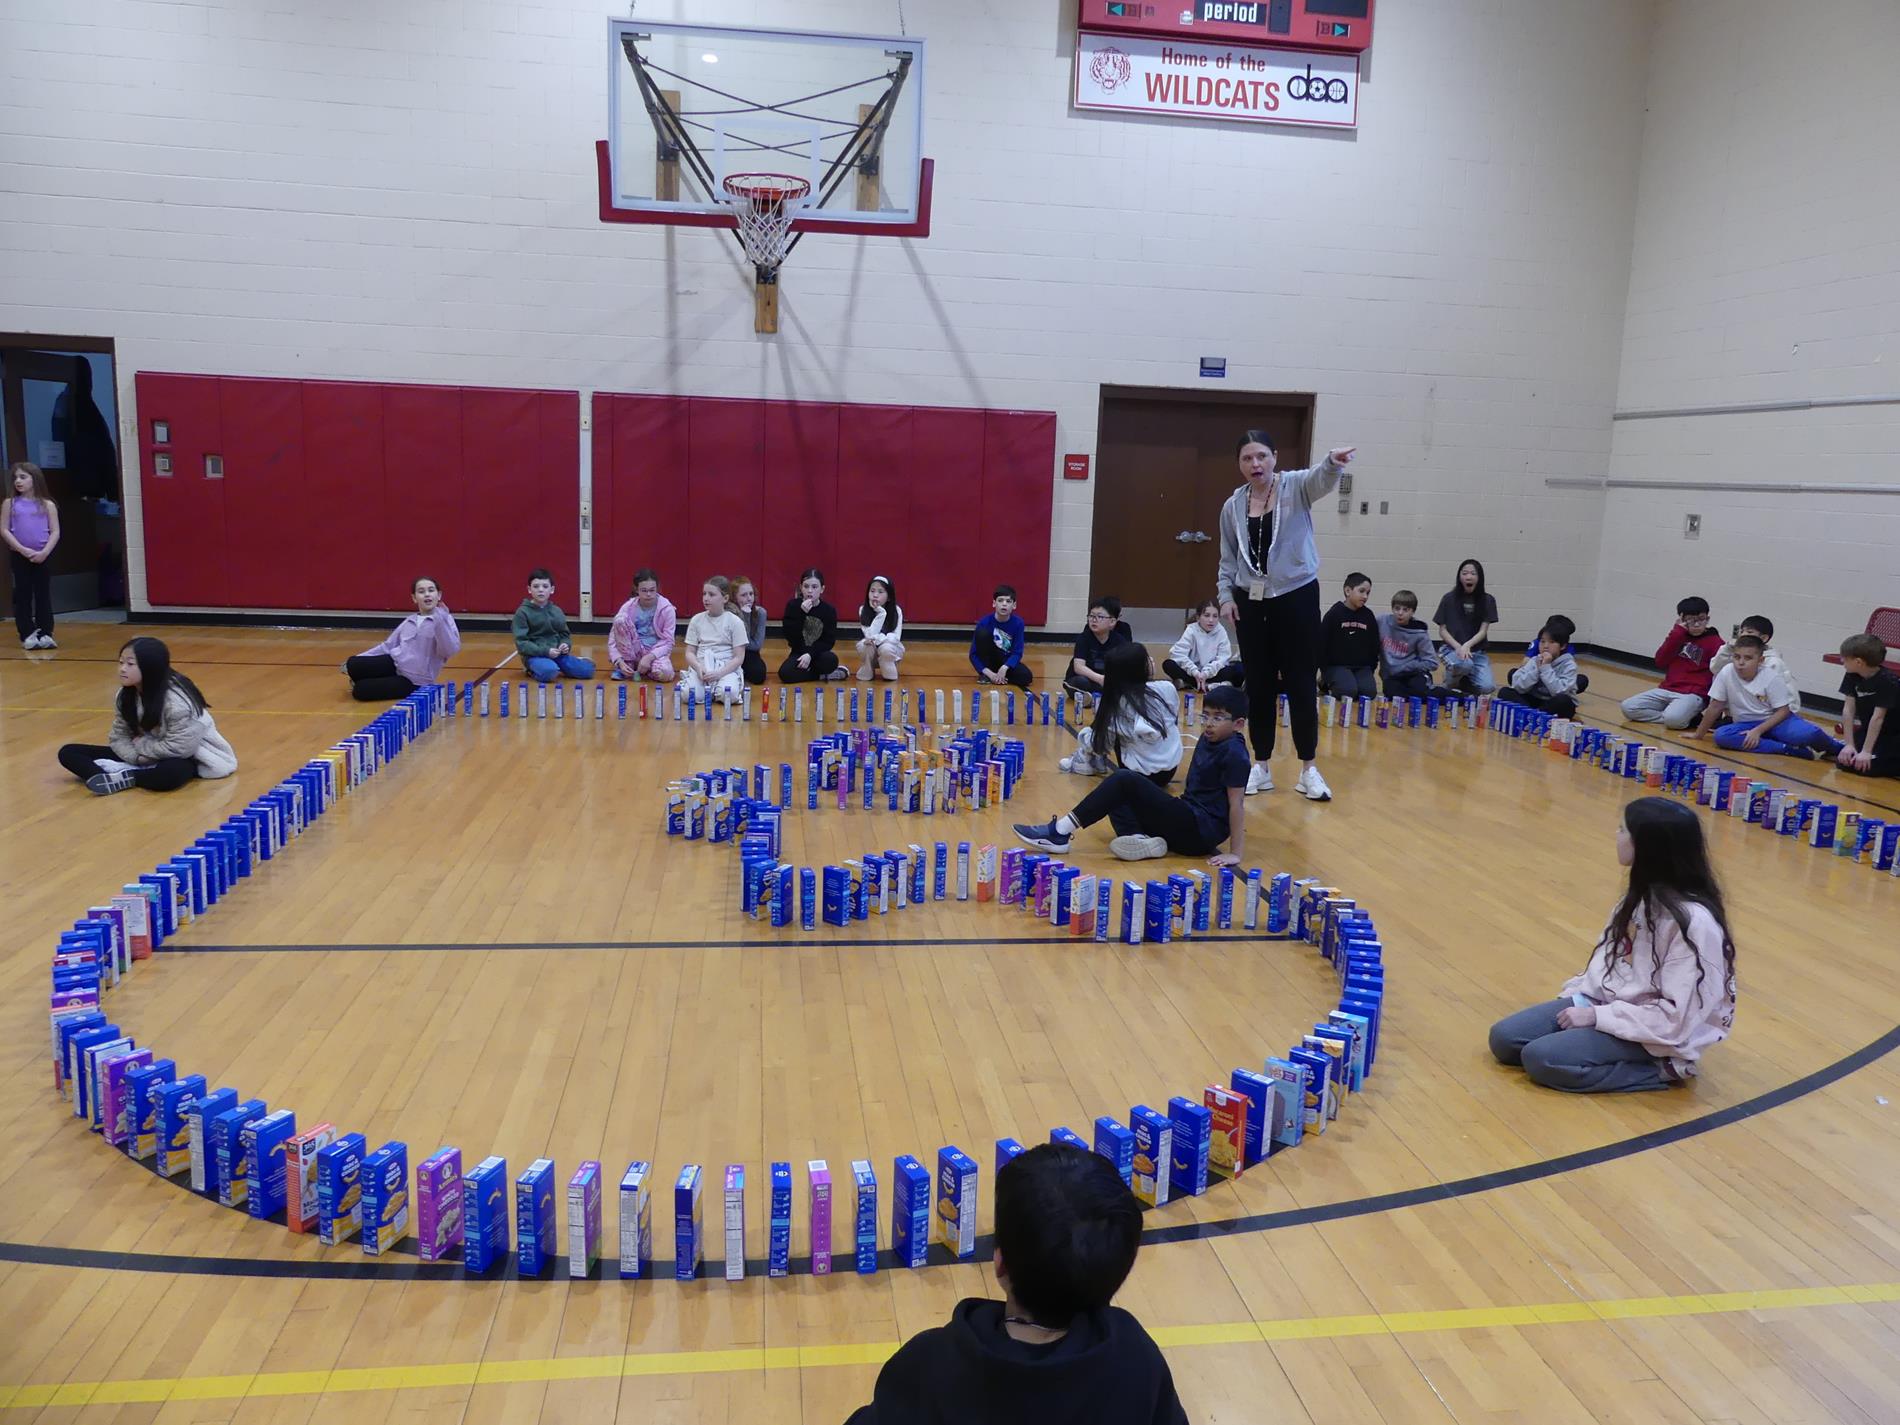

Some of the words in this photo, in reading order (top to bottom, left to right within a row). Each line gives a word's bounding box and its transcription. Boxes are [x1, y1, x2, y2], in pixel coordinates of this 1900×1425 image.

[1204, 3, 1257, 22] period
[1162, 47, 1207, 67] Home
[1216, 52, 1232, 69] of
[1240, 55, 1265, 72] the
[1145, 72, 1280, 111] WILDCATS
